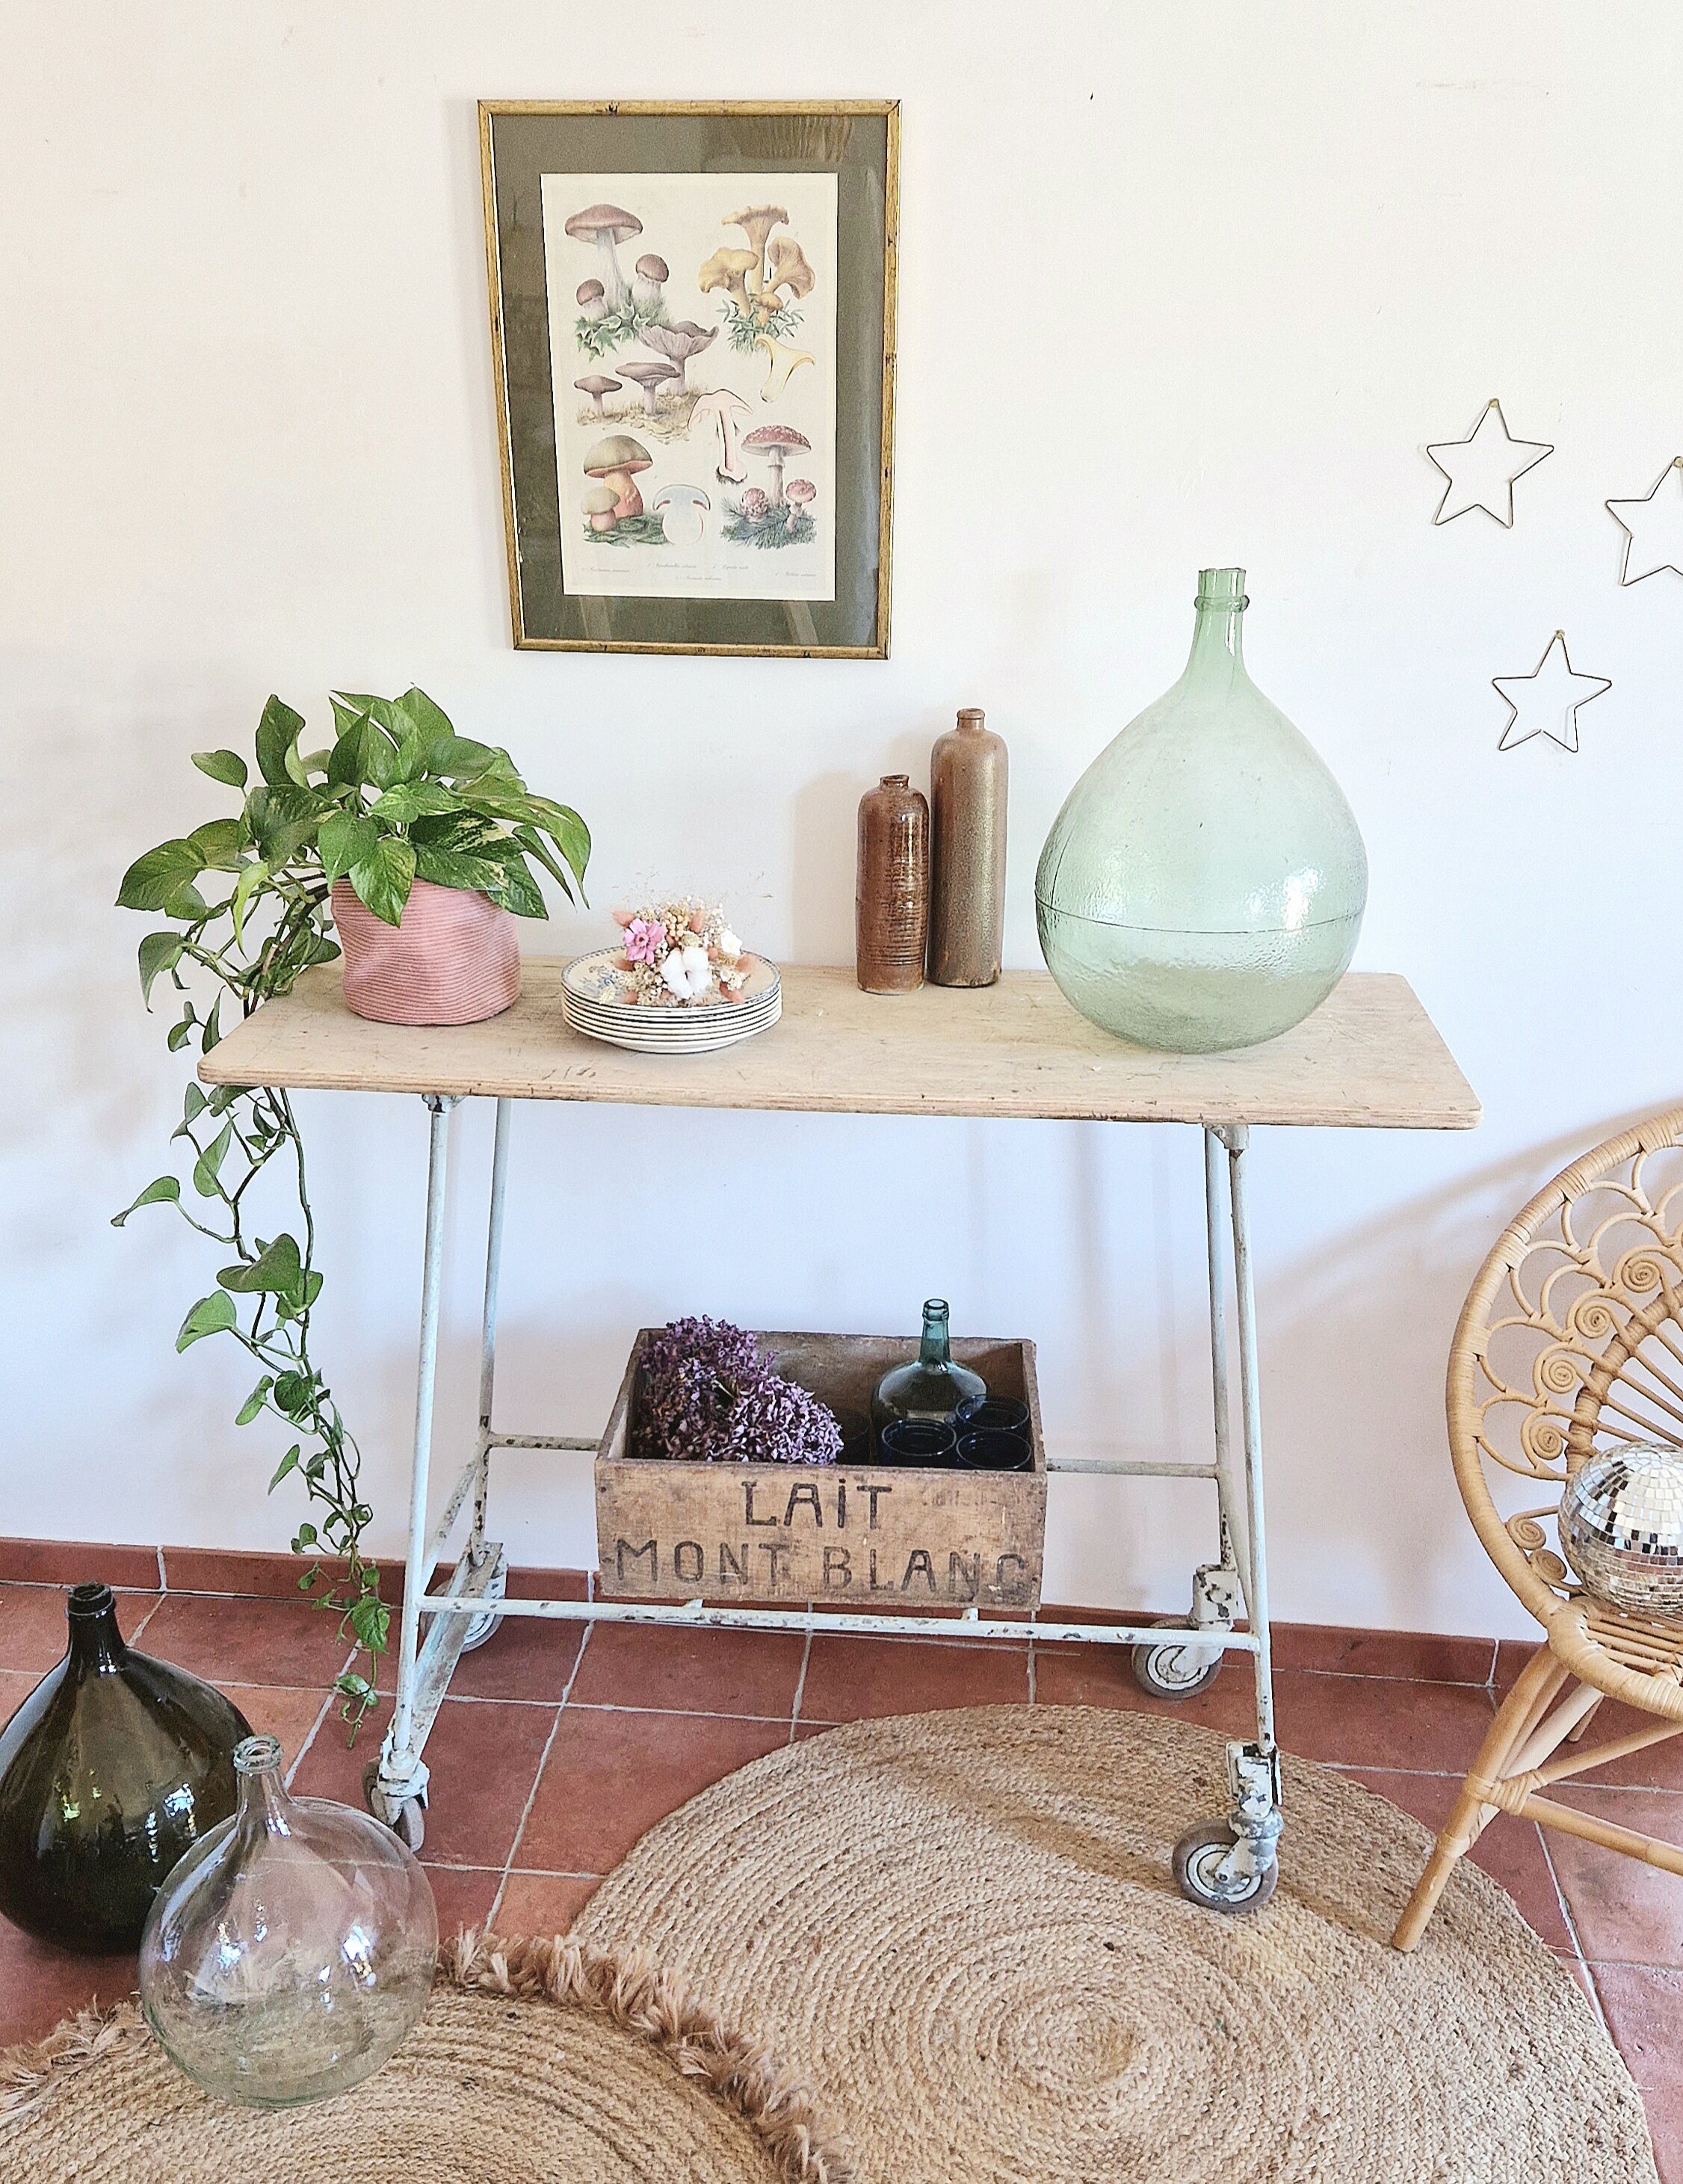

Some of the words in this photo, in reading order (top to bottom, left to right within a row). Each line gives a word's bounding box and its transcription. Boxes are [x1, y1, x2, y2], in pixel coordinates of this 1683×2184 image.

[741, 1478, 892, 1529] LAiT
[616, 1538, 789, 1586] MONT
[823, 1546, 1026, 1603] BLANC
